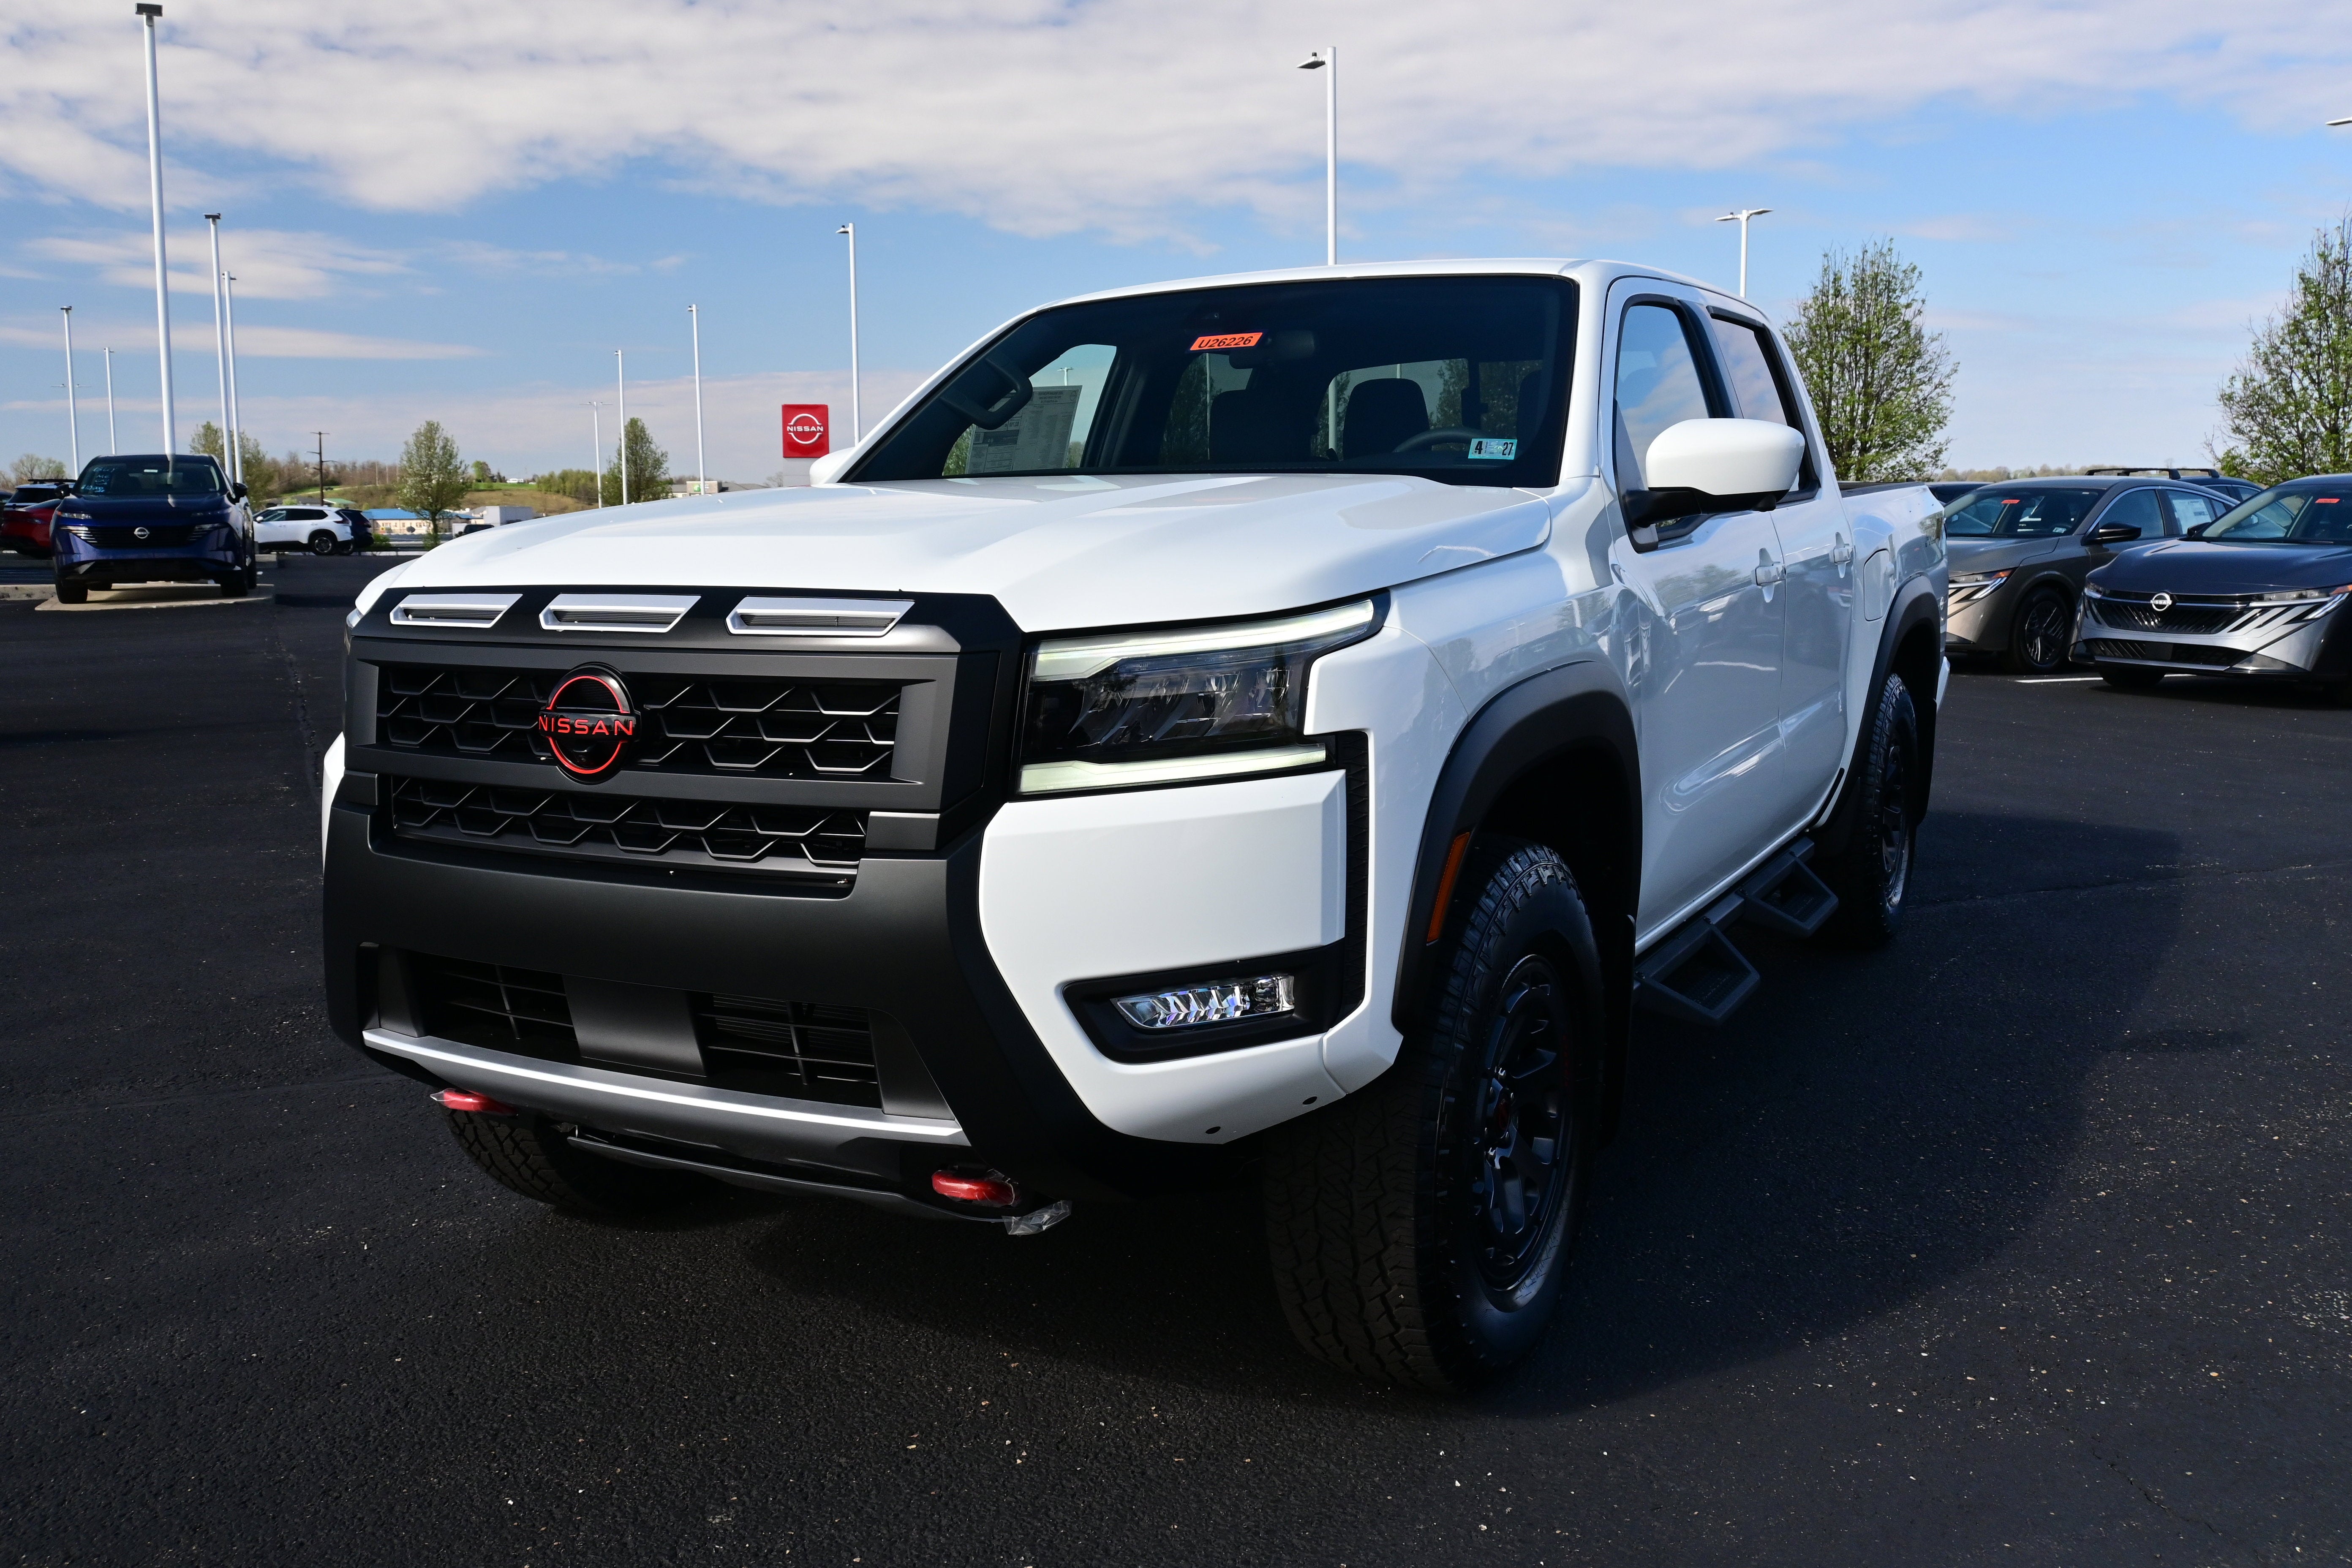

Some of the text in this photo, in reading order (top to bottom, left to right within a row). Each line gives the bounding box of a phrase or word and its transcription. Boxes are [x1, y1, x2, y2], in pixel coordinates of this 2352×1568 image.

[1198, 336, 1253, 348] U26226
[1475, 441, 1483, 455] 4
[1502, 442, 1514, 456] 27
[539, 716, 633, 735] NISSAN
